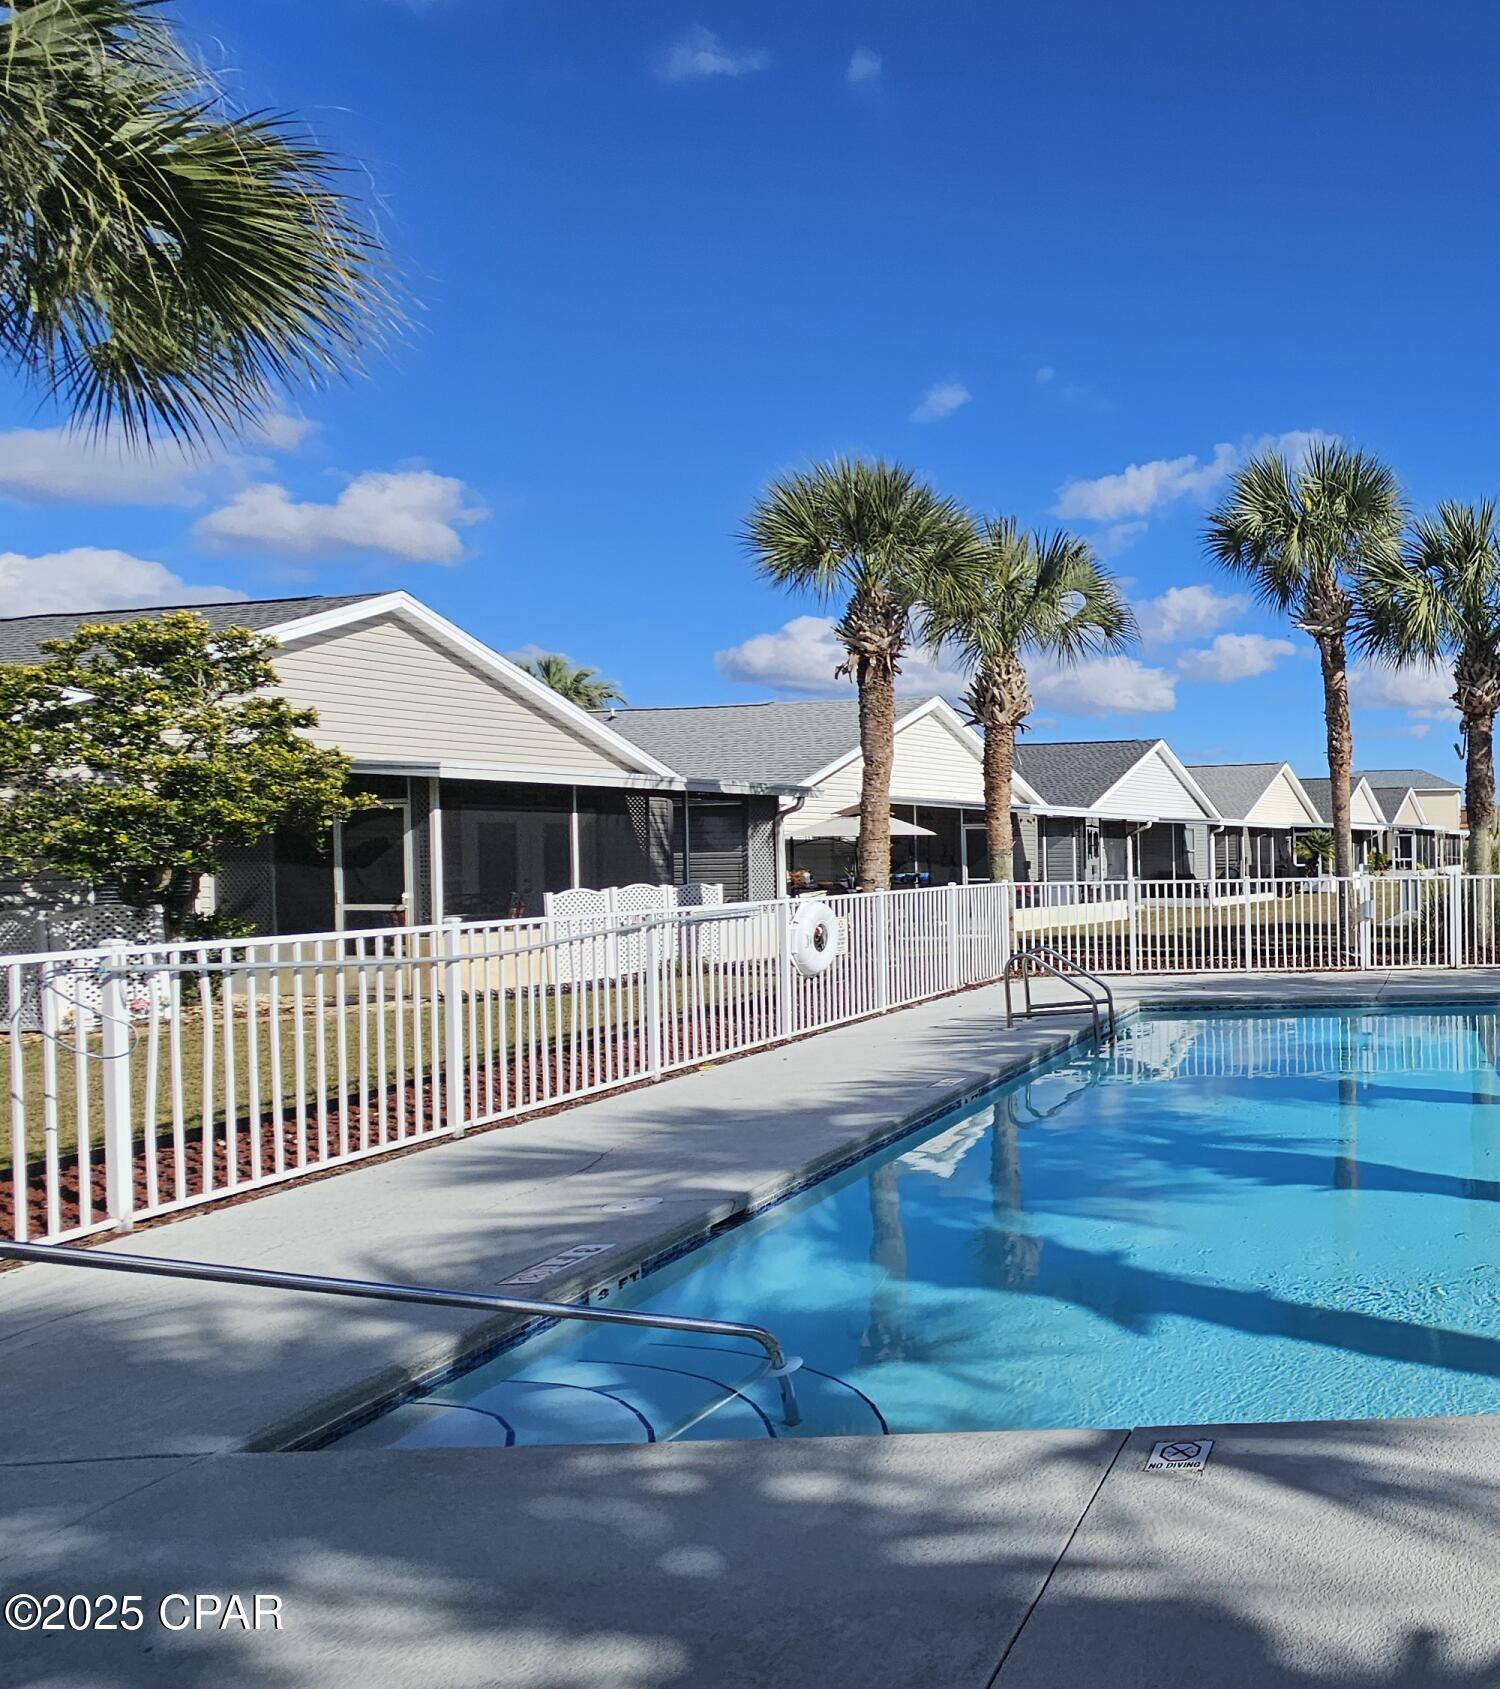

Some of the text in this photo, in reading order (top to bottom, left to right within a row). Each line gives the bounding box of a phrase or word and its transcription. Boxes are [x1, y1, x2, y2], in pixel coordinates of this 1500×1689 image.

[598, 1269, 640, 1301] 3 FT
[1165, 1461, 1201, 1469] DIVING
